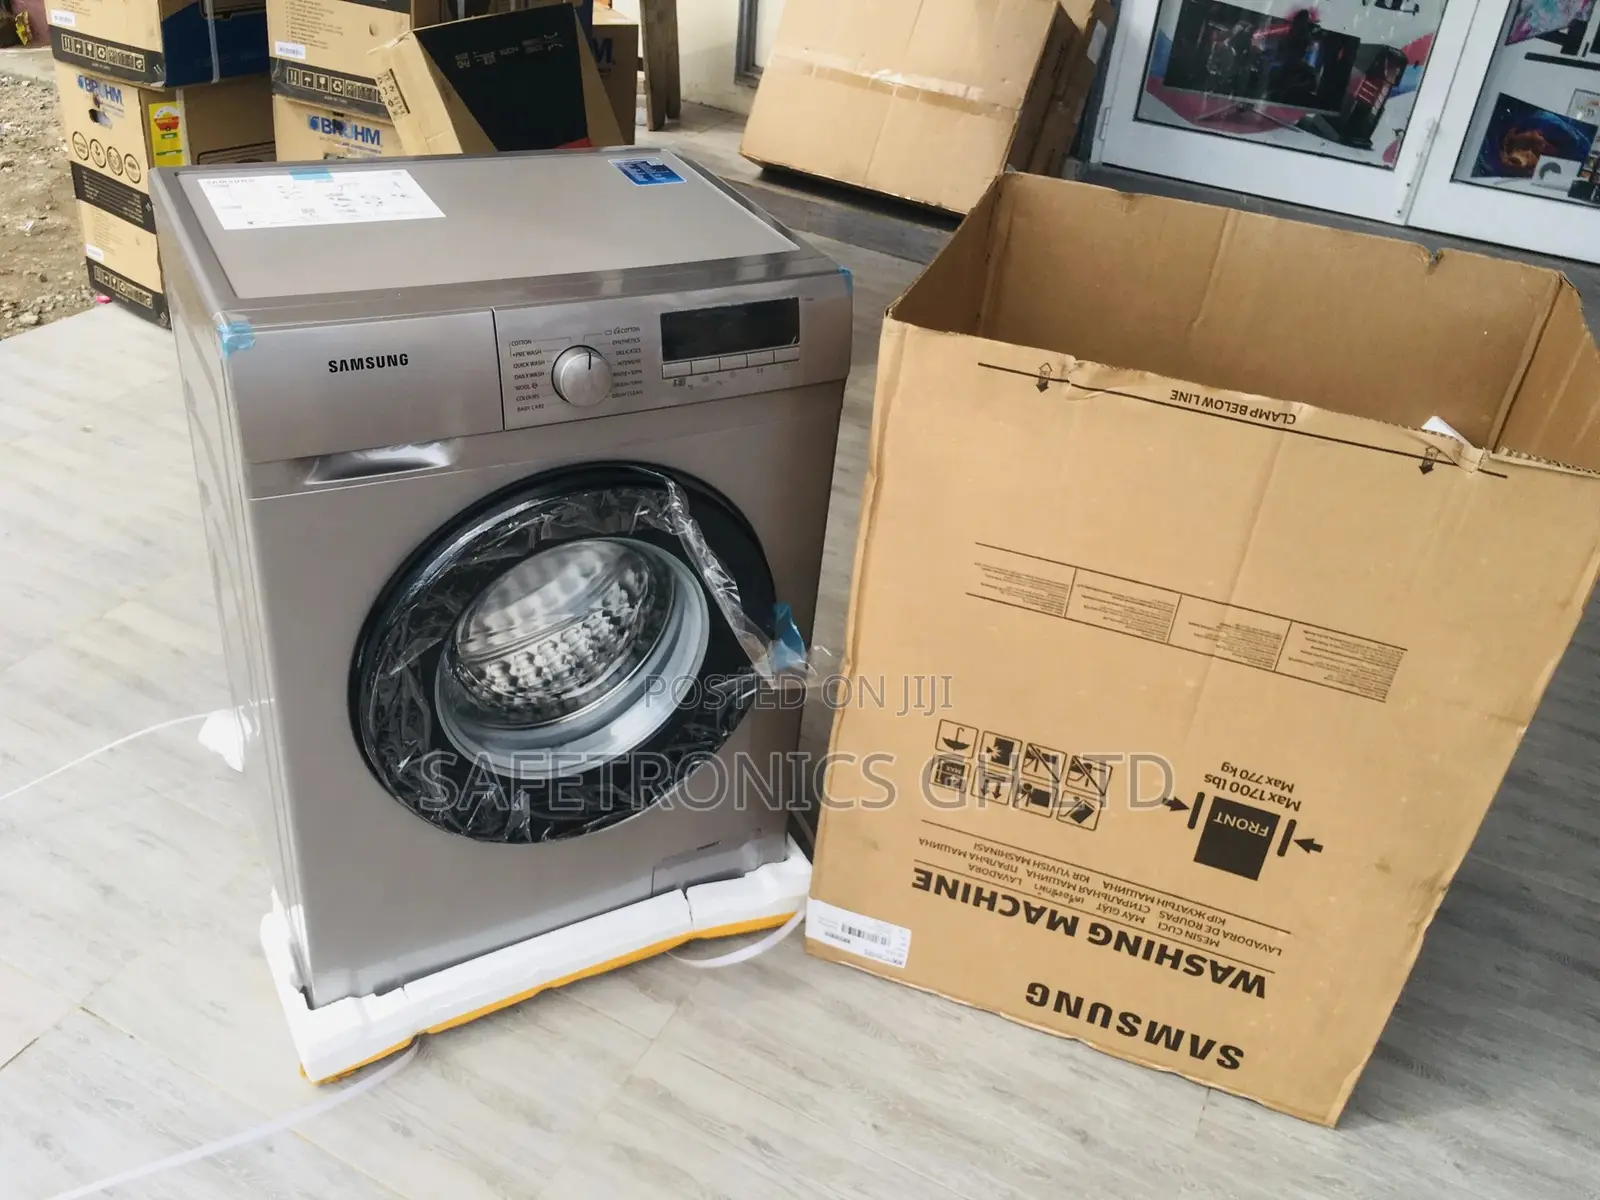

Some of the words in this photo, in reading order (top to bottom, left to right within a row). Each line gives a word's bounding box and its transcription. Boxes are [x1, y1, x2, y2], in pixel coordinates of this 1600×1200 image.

[621, 326, 640, 334] COTTON
[511, 339, 532, 347] COTTON
[328, 353, 409, 373] SAMSUNG
[530, 359, 545, 367] WASH
[1169, 389, 1200, 405] LINE
[1200, 396, 1248, 415] BELOW
[1249, 407, 1296, 424] CLAMP
[1220, 761, 1237, 777] kg
[1238, 769, 1263, 784] 770
[1203, 773, 1227, 790] lbs
[1228, 781, 1265, 801] 1700
[1264, 776, 1294, 793] Max
[1267, 791, 1301, 811] Max
[1213, 811, 1269, 836] FRONT
[918, 837, 967, 858] МАШИНА
[973, 842, 1031, 865] MASHINASI
[968, 852, 1018, 873] ПРАЛЬНА
[1031, 859, 1069, 877] YUVISH
[968, 863, 1022, 885] LAVADORA
[1026, 868, 1077, 891] МАШИНА
[1072, 871, 1090, 883] KIR
[1077, 885, 1150, 913] СТИРАЛЬНАЯ
[1102, 880, 1155, 903] МАШИНА
[911, 867, 1079, 937] MACHINE
[1120, 910, 1145, 923] MÁY
[1158, 910, 1203, 930] ROUPAS
[1157, 921, 1183, 935] CUCI
[1203, 924, 1220, 936] DE
[1184, 929, 1220, 947] MESIN
[1222, 929, 1282, 956] LAVADORA
[1086, 922, 1265, 999] WASHING
[1025, 982, 1244, 1069] SAMSUNG
